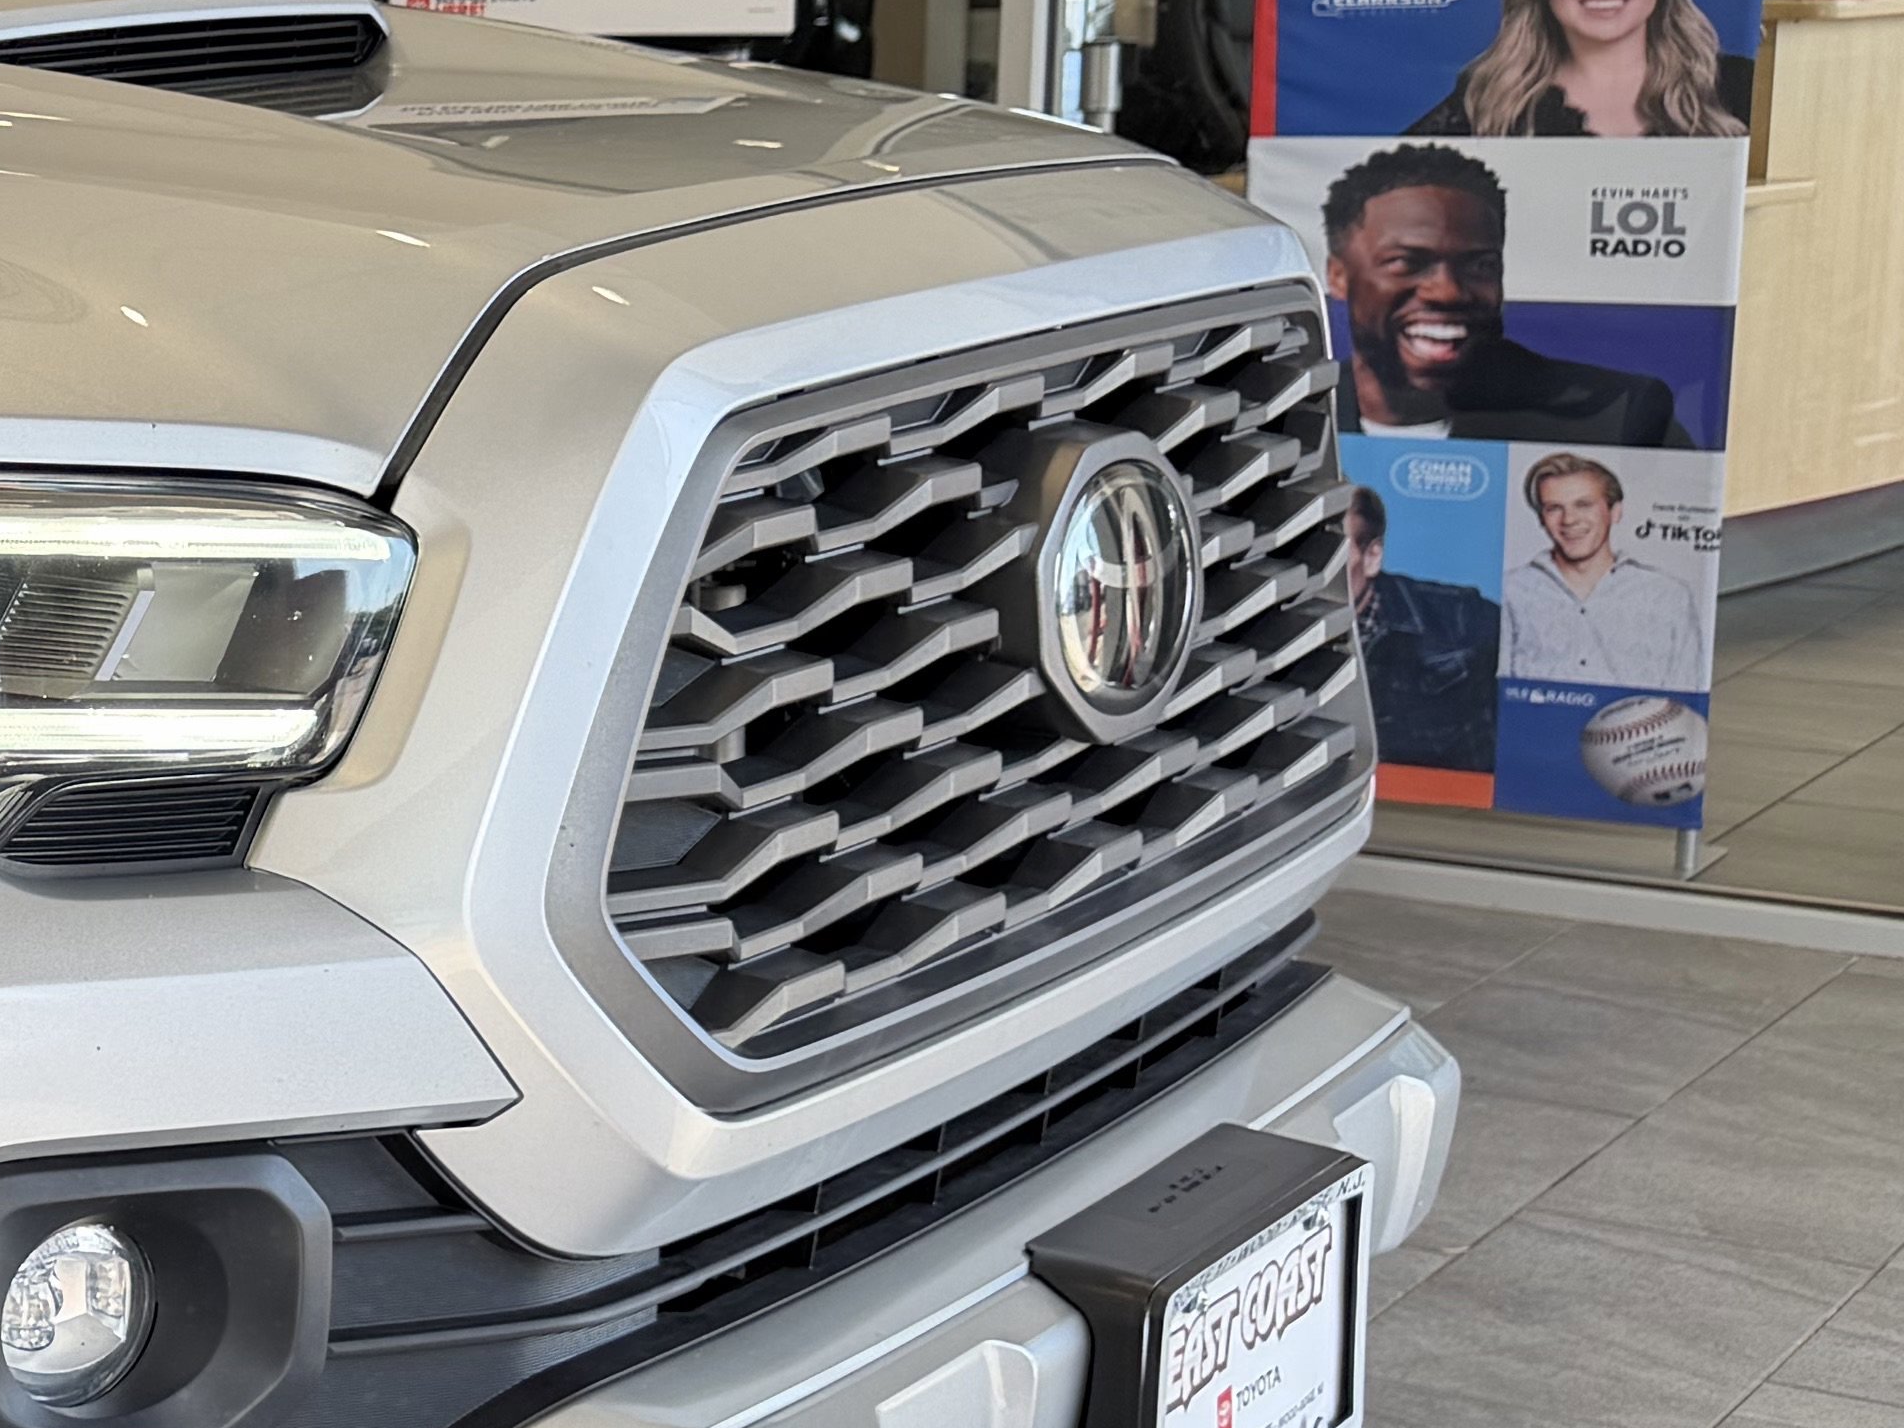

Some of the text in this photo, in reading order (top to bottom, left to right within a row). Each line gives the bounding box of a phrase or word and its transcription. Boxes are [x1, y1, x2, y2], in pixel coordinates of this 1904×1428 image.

[1591, 187, 1634, 199] KEVIN
[1590, 200, 1687, 236] LOL
[1166, 1286, 1241, 1416] EAST
[1240, 1223, 1333, 1351] COAST
[1235, 1365, 1282, 1412] TOYOTA
